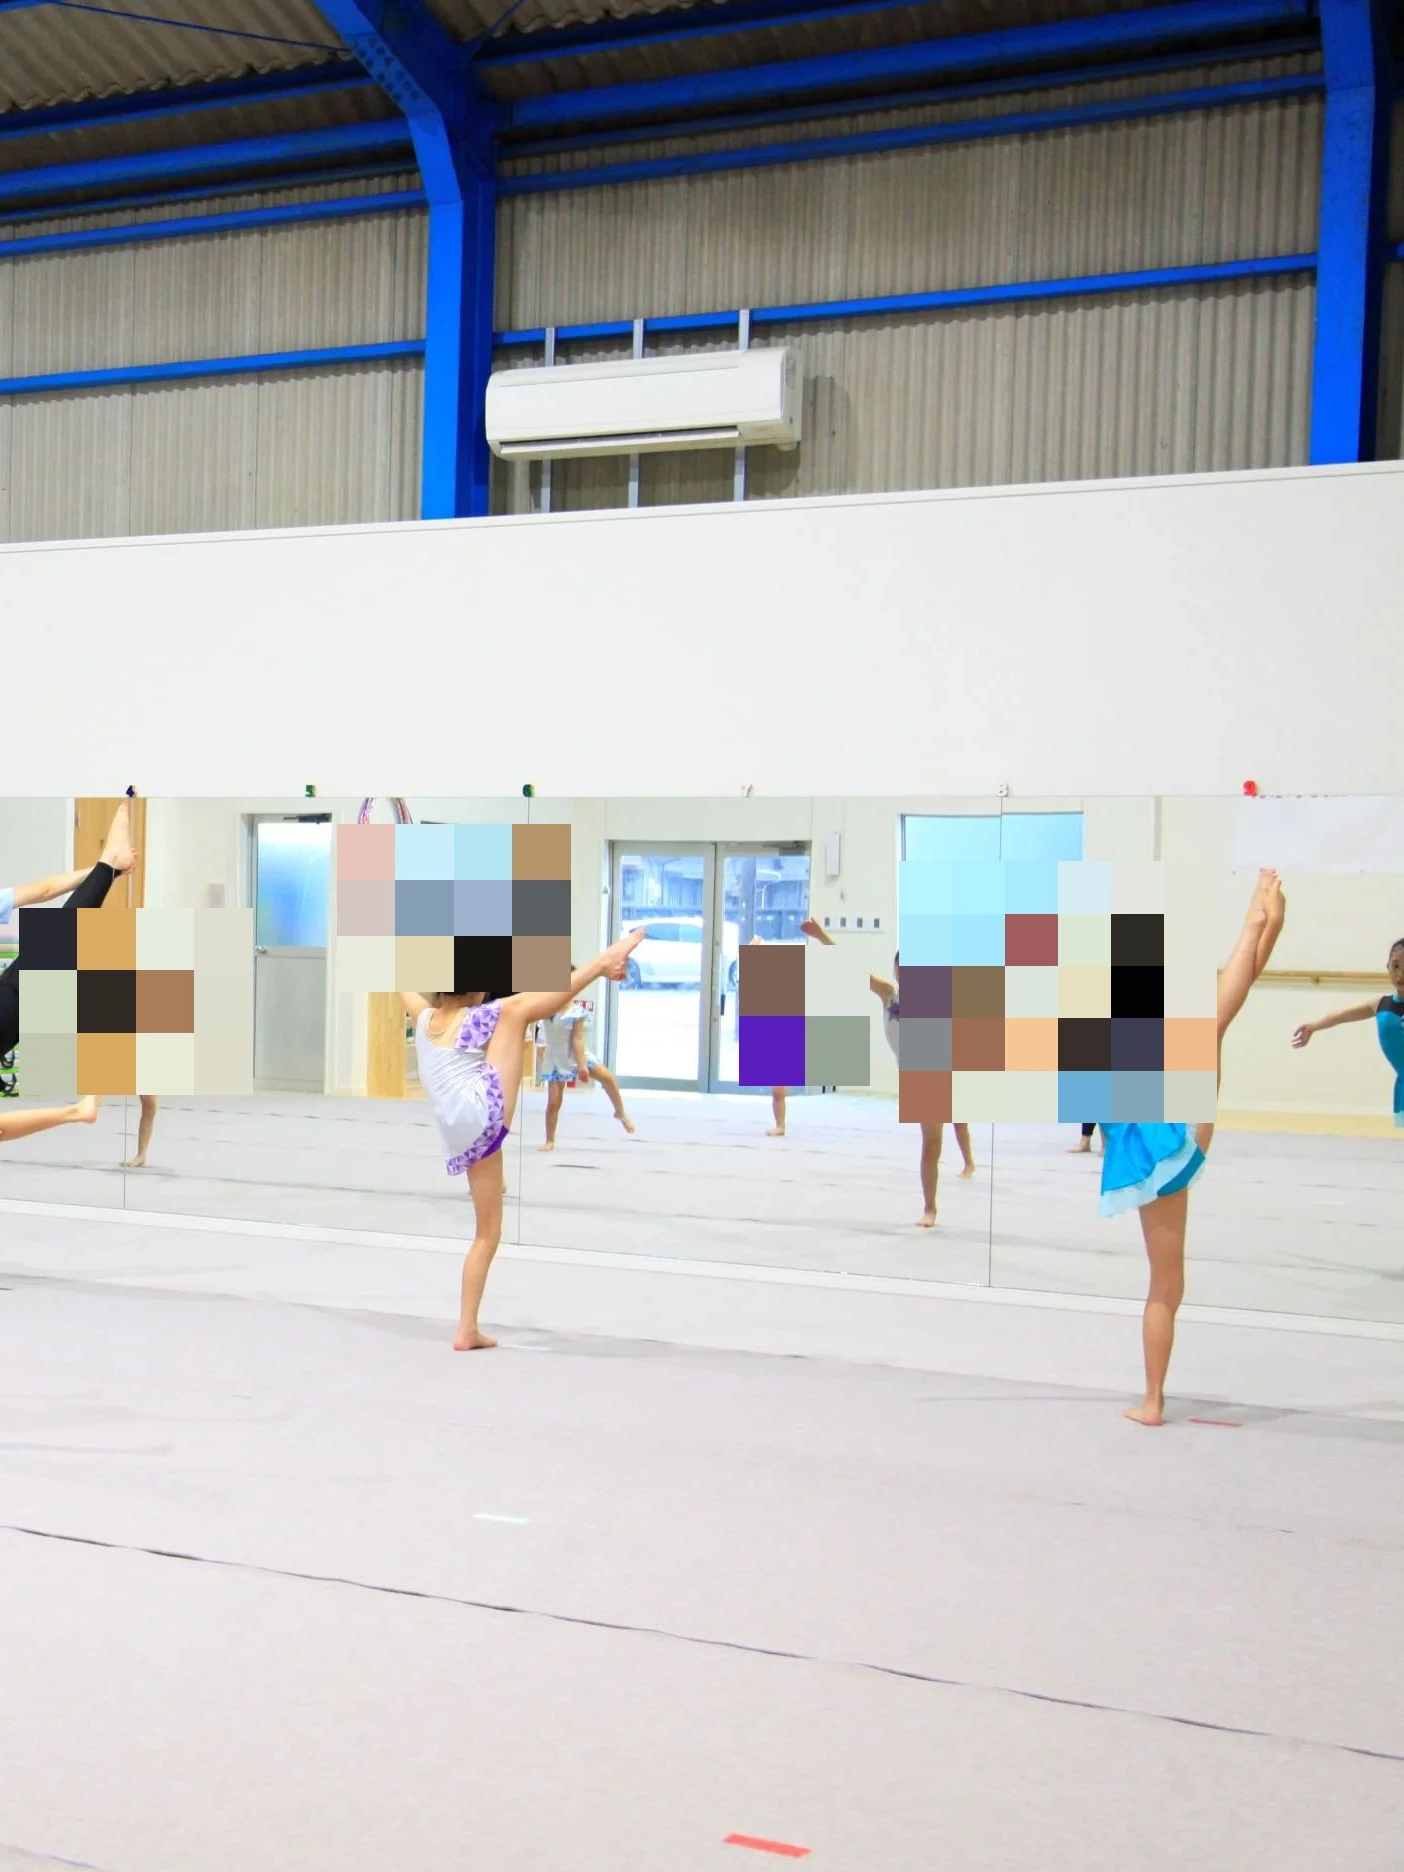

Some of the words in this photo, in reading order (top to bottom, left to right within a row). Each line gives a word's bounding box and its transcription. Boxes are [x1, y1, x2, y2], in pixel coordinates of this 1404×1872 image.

[125, 785, 136, 797] 4
[305, 784, 315, 797] 5
[522, 784, 533, 798] 6
[1243, 780, 1257, 798] 9
